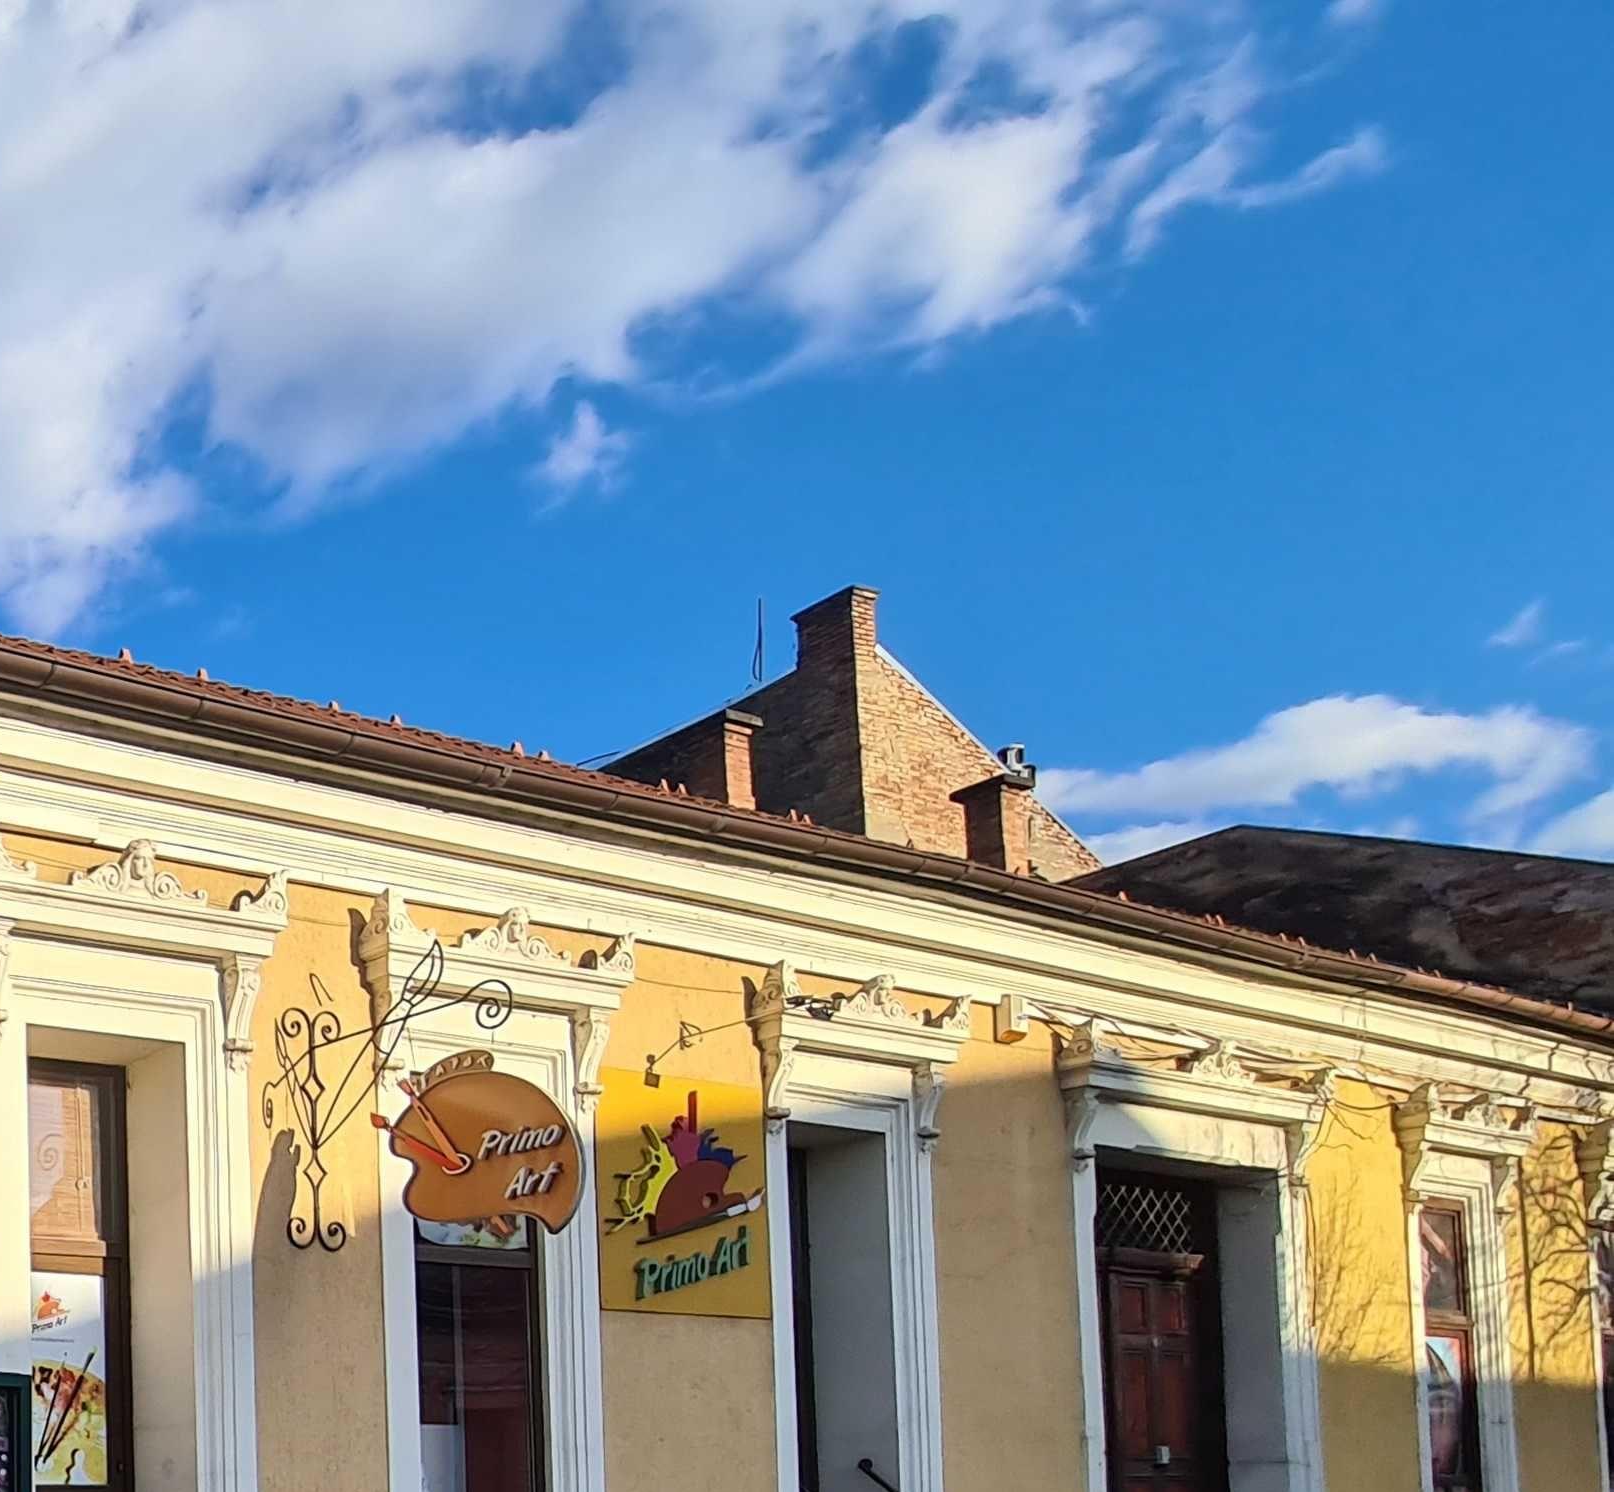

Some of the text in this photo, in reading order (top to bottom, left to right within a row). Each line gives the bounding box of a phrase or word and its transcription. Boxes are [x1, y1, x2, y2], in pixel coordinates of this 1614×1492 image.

[477, 1124, 563, 1160] Primo
[504, 1161, 562, 1200] Art
[634, 1225, 750, 1300] Primo Art
